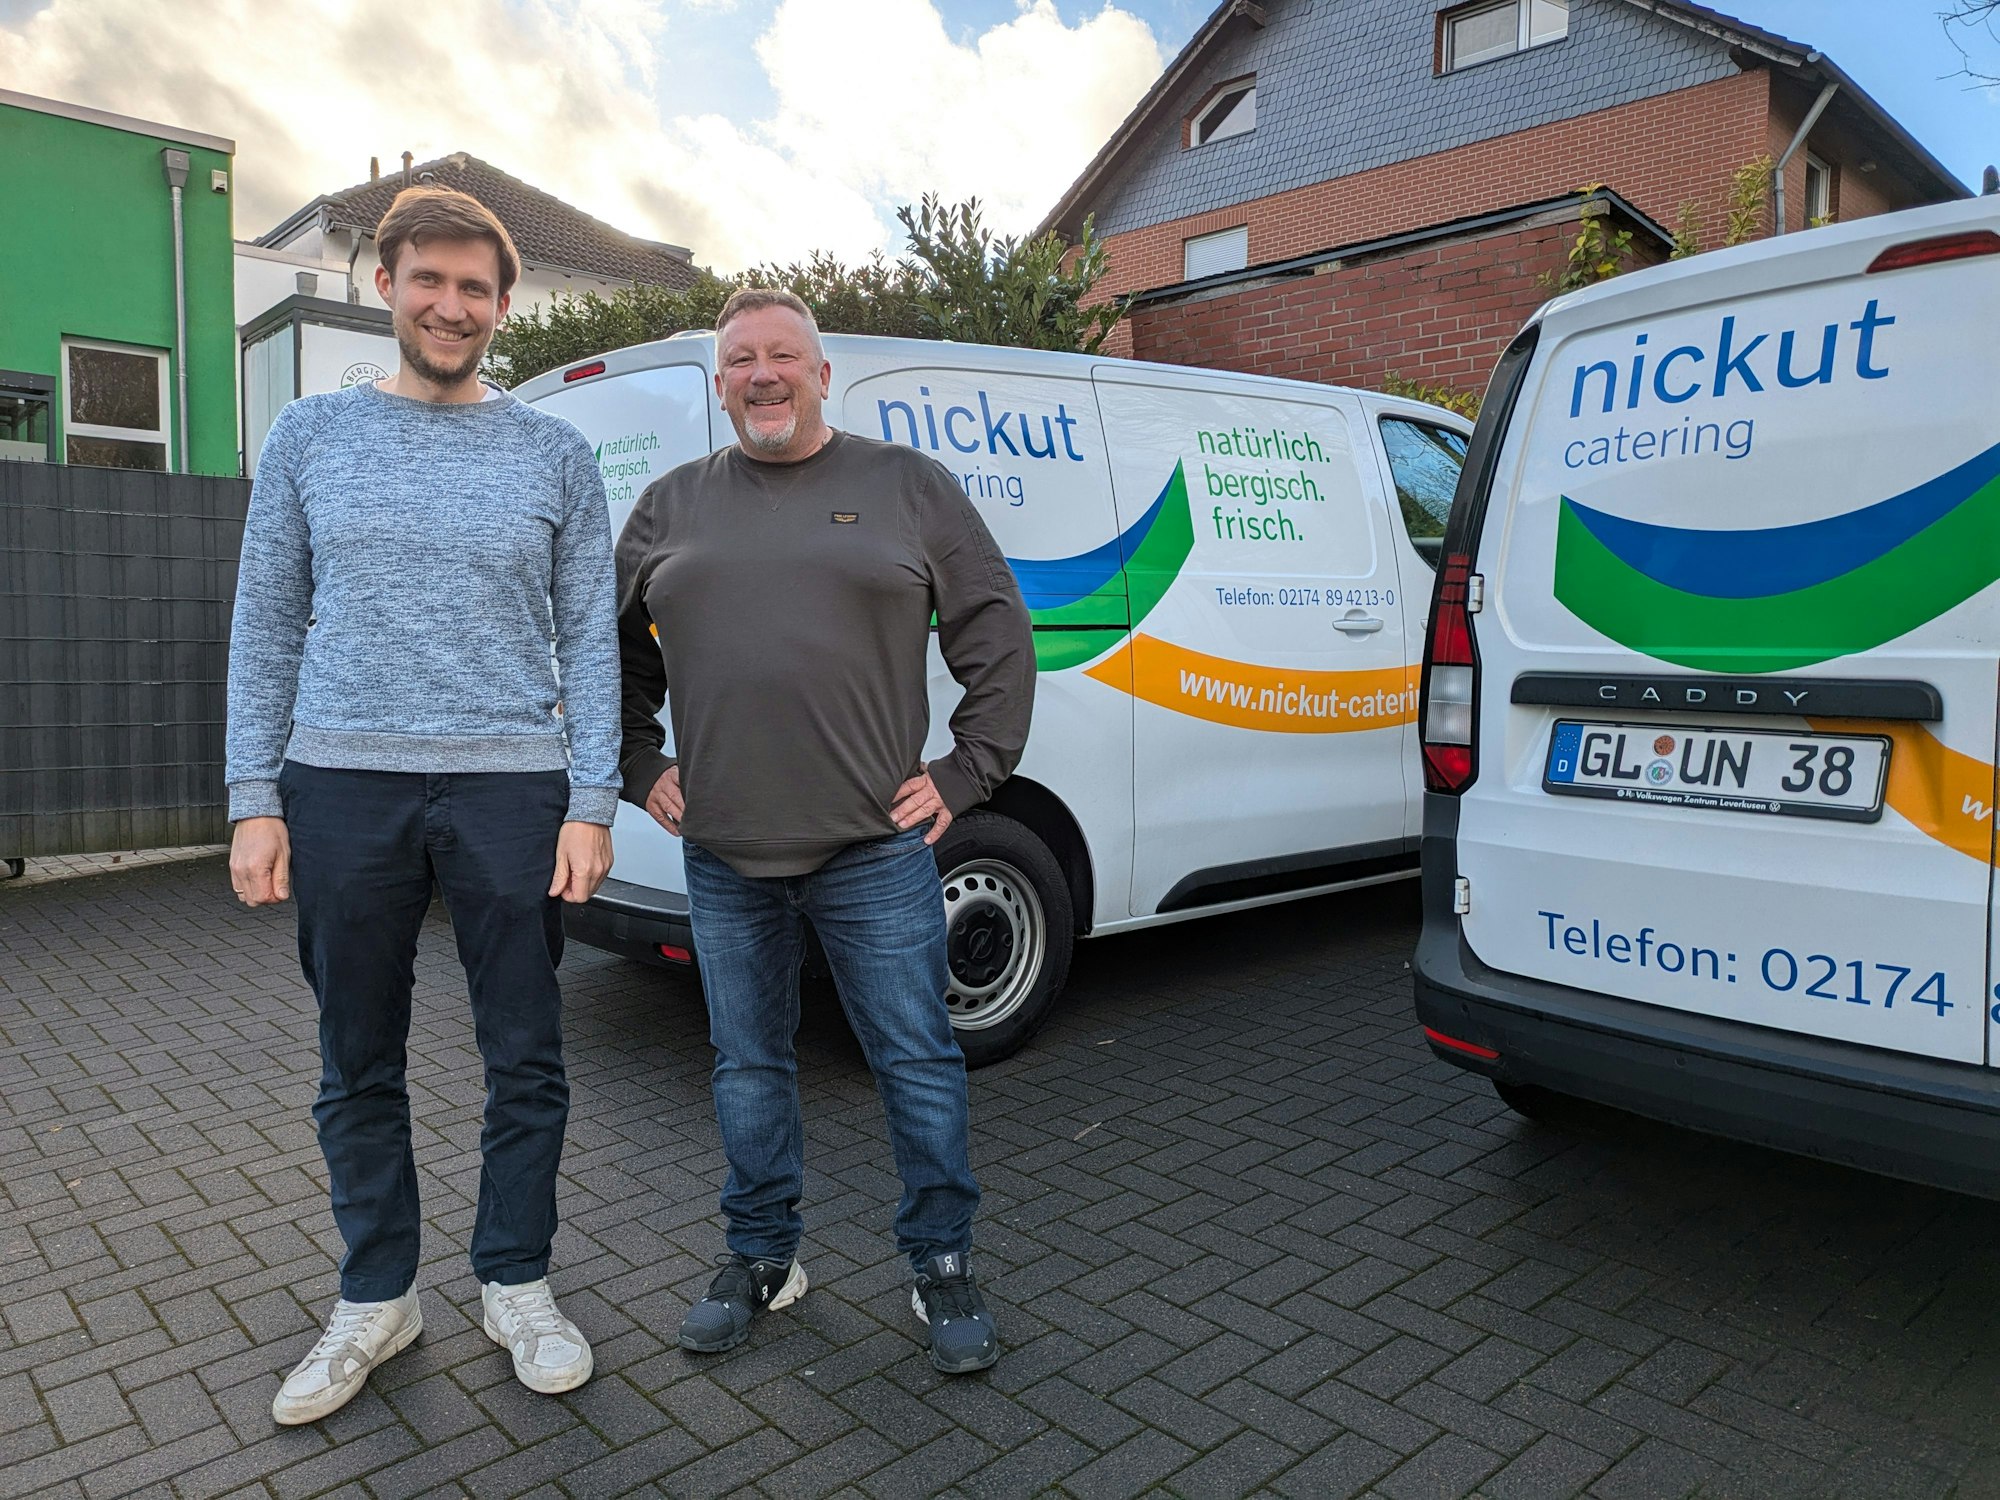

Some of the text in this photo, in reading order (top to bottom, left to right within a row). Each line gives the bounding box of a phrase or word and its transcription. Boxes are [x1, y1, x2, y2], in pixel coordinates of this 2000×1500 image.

[1569, 299, 1897, 418] nickut
[604, 430, 661, 456] natürlich.
[878, 386, 1085, 462] nickut
[1563, 416, 1755, 470] catering
[1197, 427, 1331, 464] natürlich.
[602, 456, 651, 481] bergisch.
[951, 466, 1025, 507] ring
[1204, 463, 1326, 506] bergisch.
[605, 481, 635, 501] isch.
[1212, 506, 1304, 541] frisch.
[1215, 587, 1275, 606] Telefon:
[1278, 588, 1320, 606] 02174
[1180, 669, 1420, 719] www.nickut-cateri
[1599, 685, 1808, 706] CADDY
[1557, 759, 1569, 773] D
[1581, 732, 1642, 780] GL
[1679, 738, 1753, 788] UN
[1781, 743, 1855, 797] 38
[1636, 791, 1682, 803] Volkswagen
[1684, 796, 1717, 806] Zentrum
[1719, 799, 1767, 810] Leverkusen
[1539, 911, 1738, 983] Telefon:
[1761, 947, 1954, 1017] 02174
